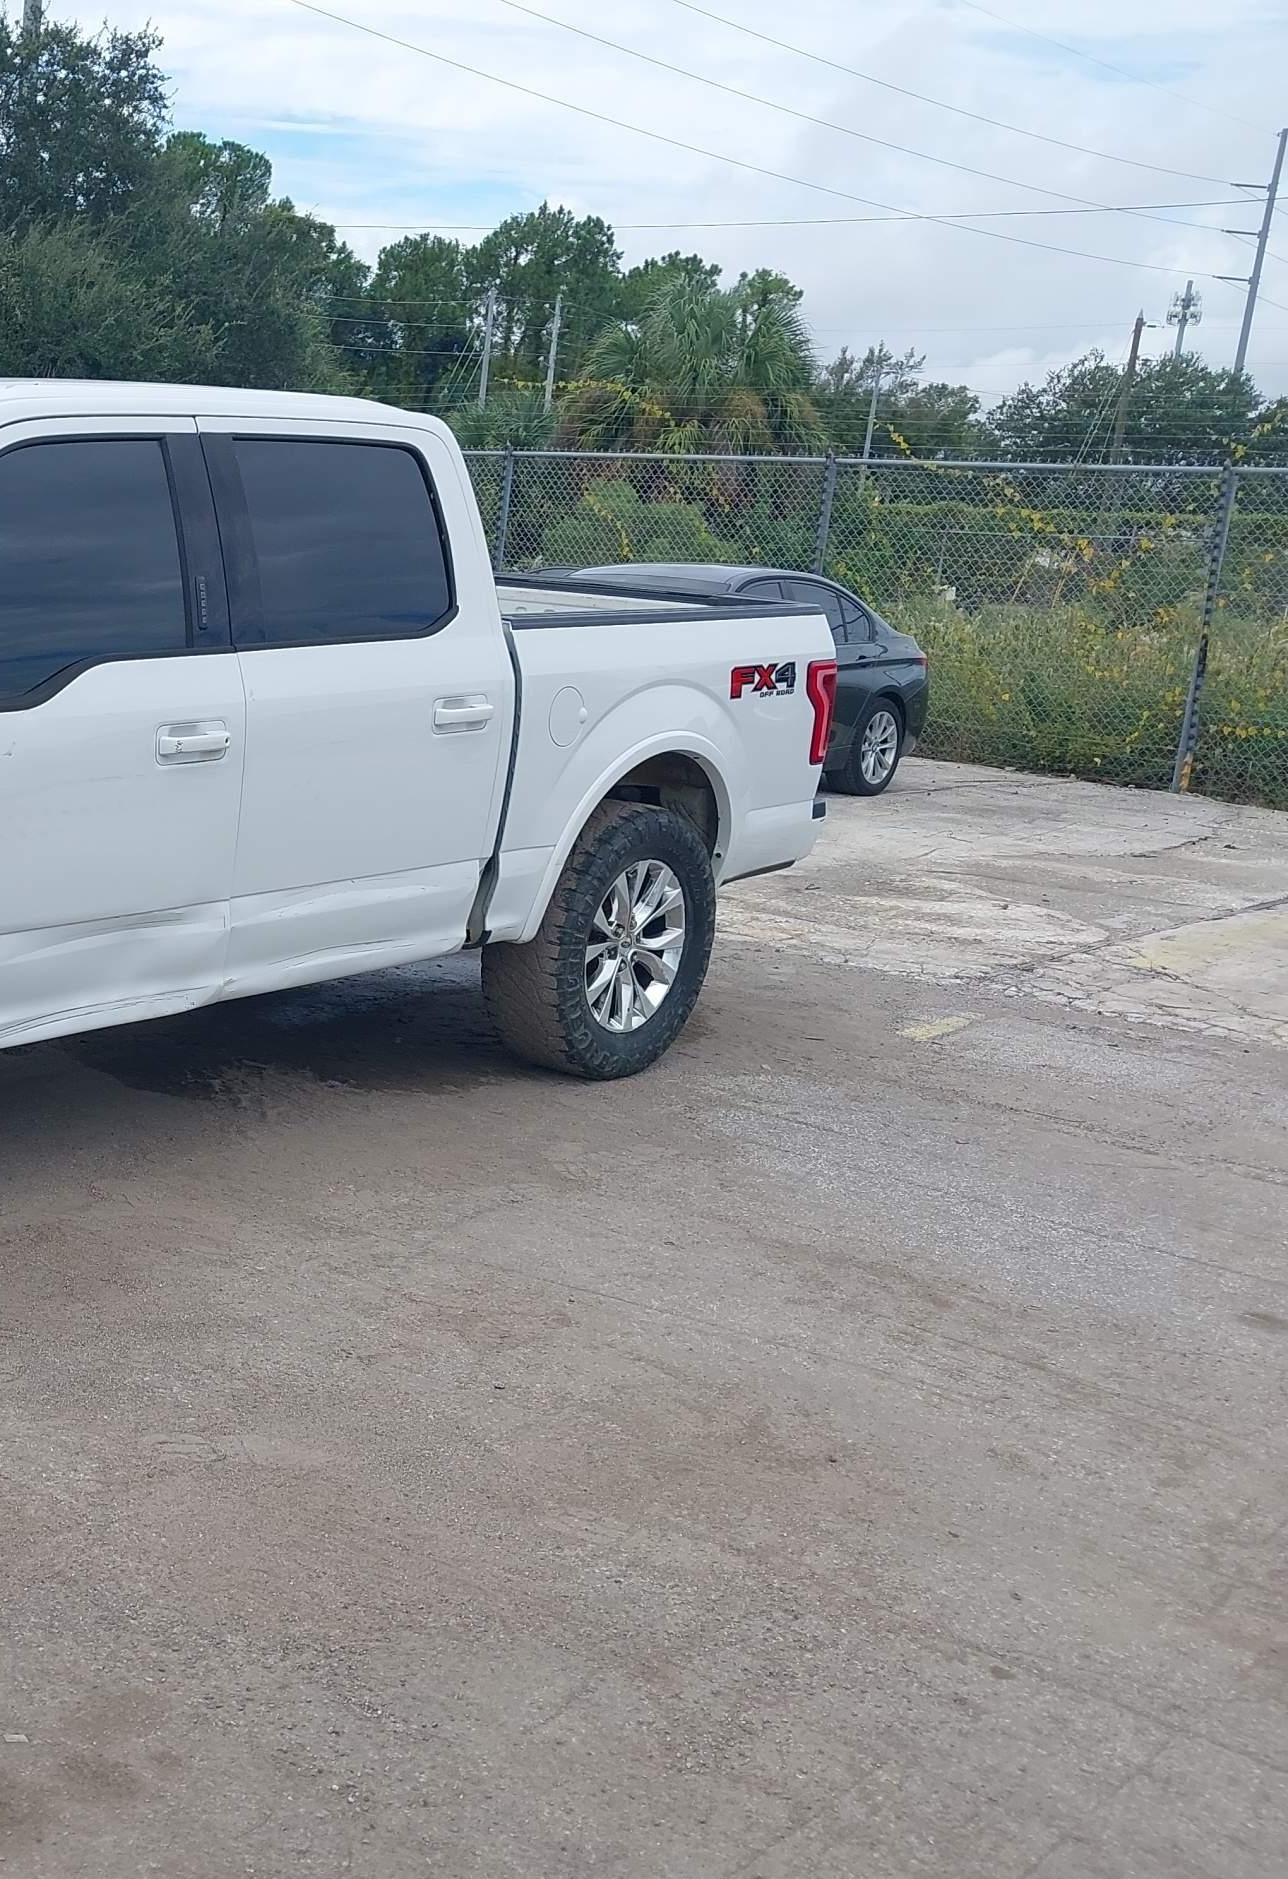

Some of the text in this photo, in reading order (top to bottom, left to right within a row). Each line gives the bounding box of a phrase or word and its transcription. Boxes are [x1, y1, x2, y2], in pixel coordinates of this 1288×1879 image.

[730, 661, 797, 700] FX4
[759, 688, 795, 698] OFF ROAD
